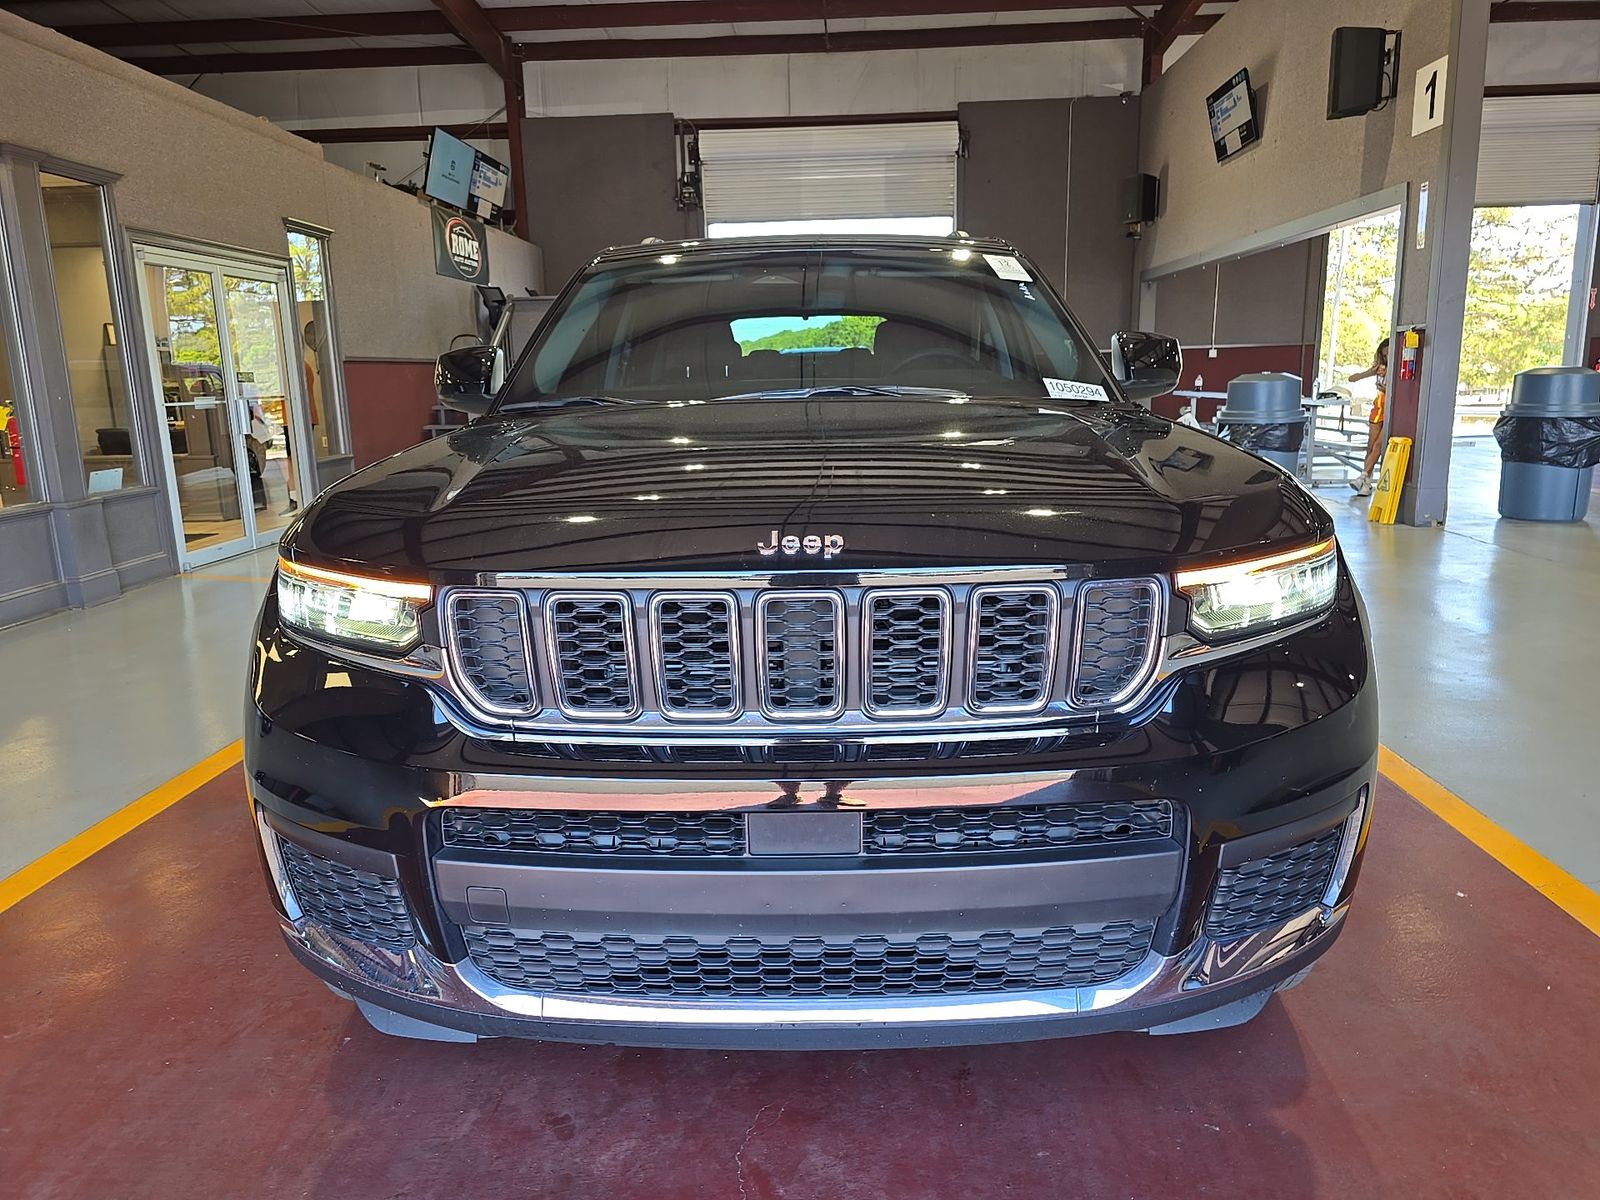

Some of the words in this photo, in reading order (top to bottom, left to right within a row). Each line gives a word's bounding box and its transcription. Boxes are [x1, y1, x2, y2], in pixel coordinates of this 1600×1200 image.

[1425, 70, 1438, 120] 1
[1049, 381, 1102, 397] 1050294
[757, 530, 844, 559] Jeep
